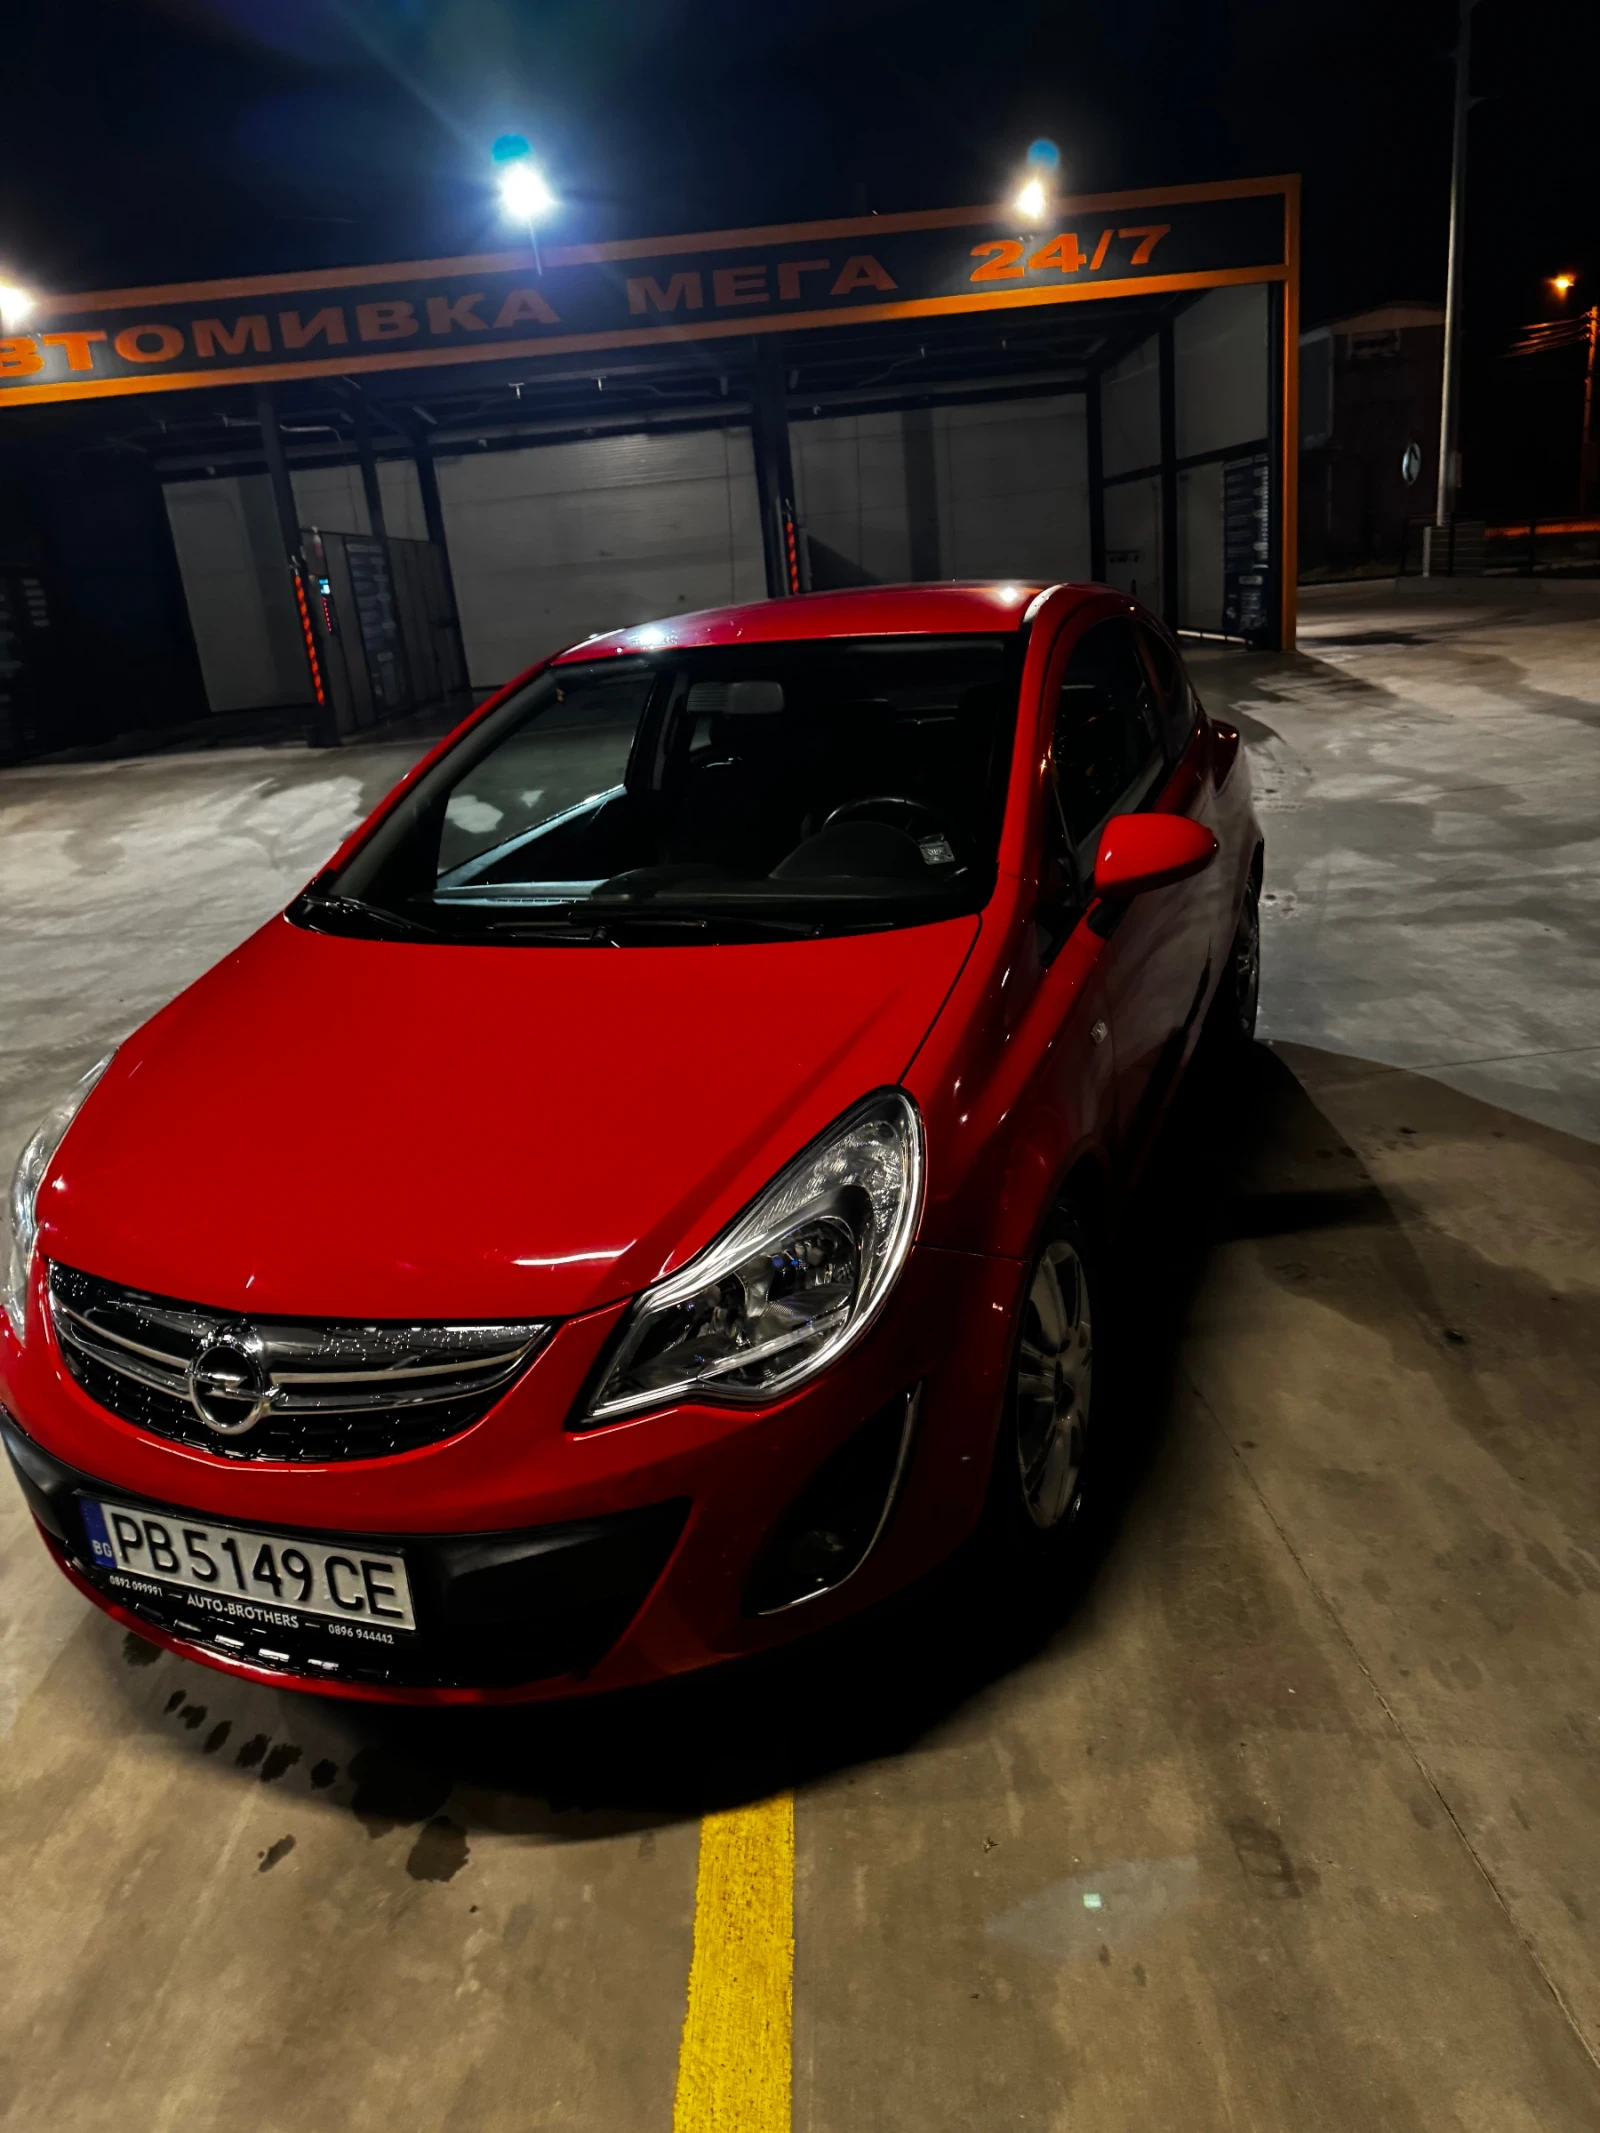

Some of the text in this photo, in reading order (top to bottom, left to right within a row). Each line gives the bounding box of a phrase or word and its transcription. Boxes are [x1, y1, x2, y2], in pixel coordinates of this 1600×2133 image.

[626, 254, 899, 315] МЕГА
[969, 224, 1172, 282] 24/7
[92, 1539, 113, 1559] BG
[186, 1592, 300, 1629] AUTO-BROTHERS
[328, 1623, 354, 1638] 0896
[356, 1627, 395, 1645] 944442
